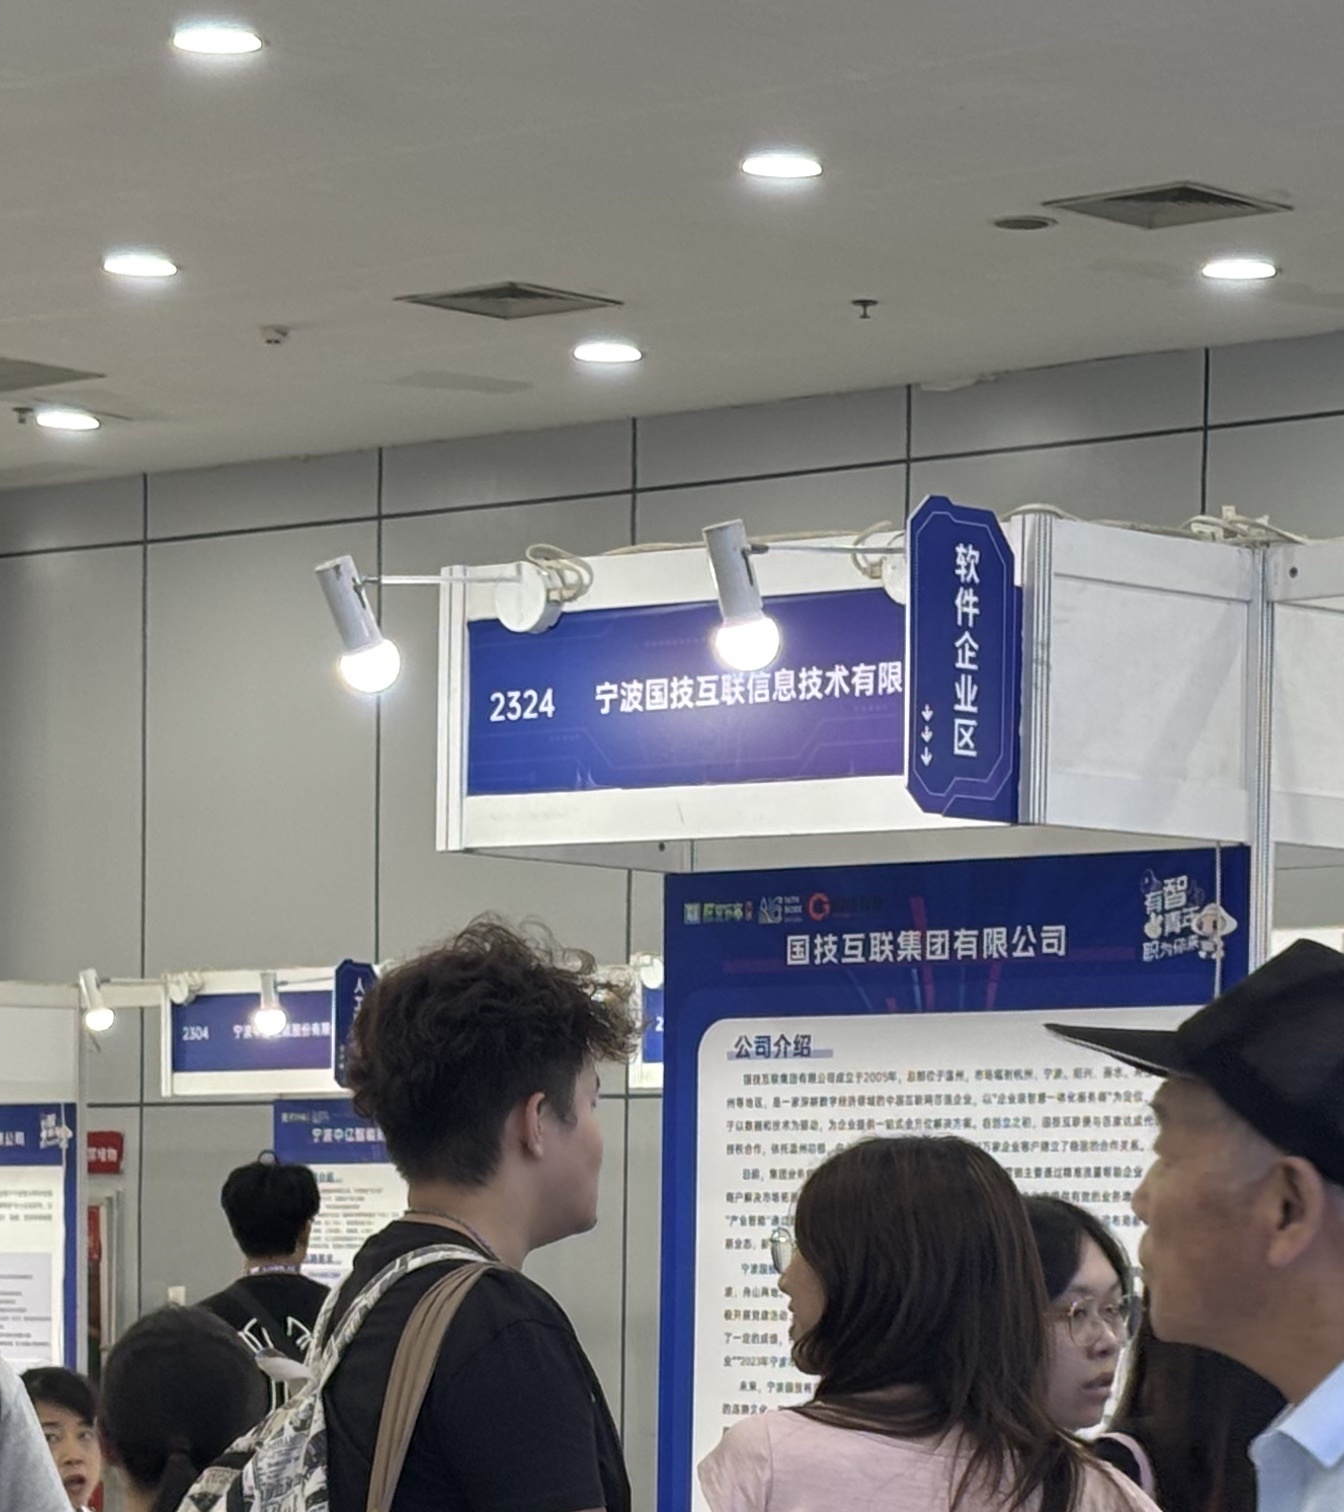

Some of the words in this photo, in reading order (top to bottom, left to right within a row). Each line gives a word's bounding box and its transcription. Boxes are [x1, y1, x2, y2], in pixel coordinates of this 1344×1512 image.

[952, 543, 981, 758] 软件企业区
[488, 687, 556, 723] 2324
[594, 660, 904, 717] 宁波国技互联信息技术有限
[785, 924, 1068, 968] 国技互联集团有限公司
[182, 1025, 210, 1042] 2304
[733, 1033, 813, 1059] 公司介绍
